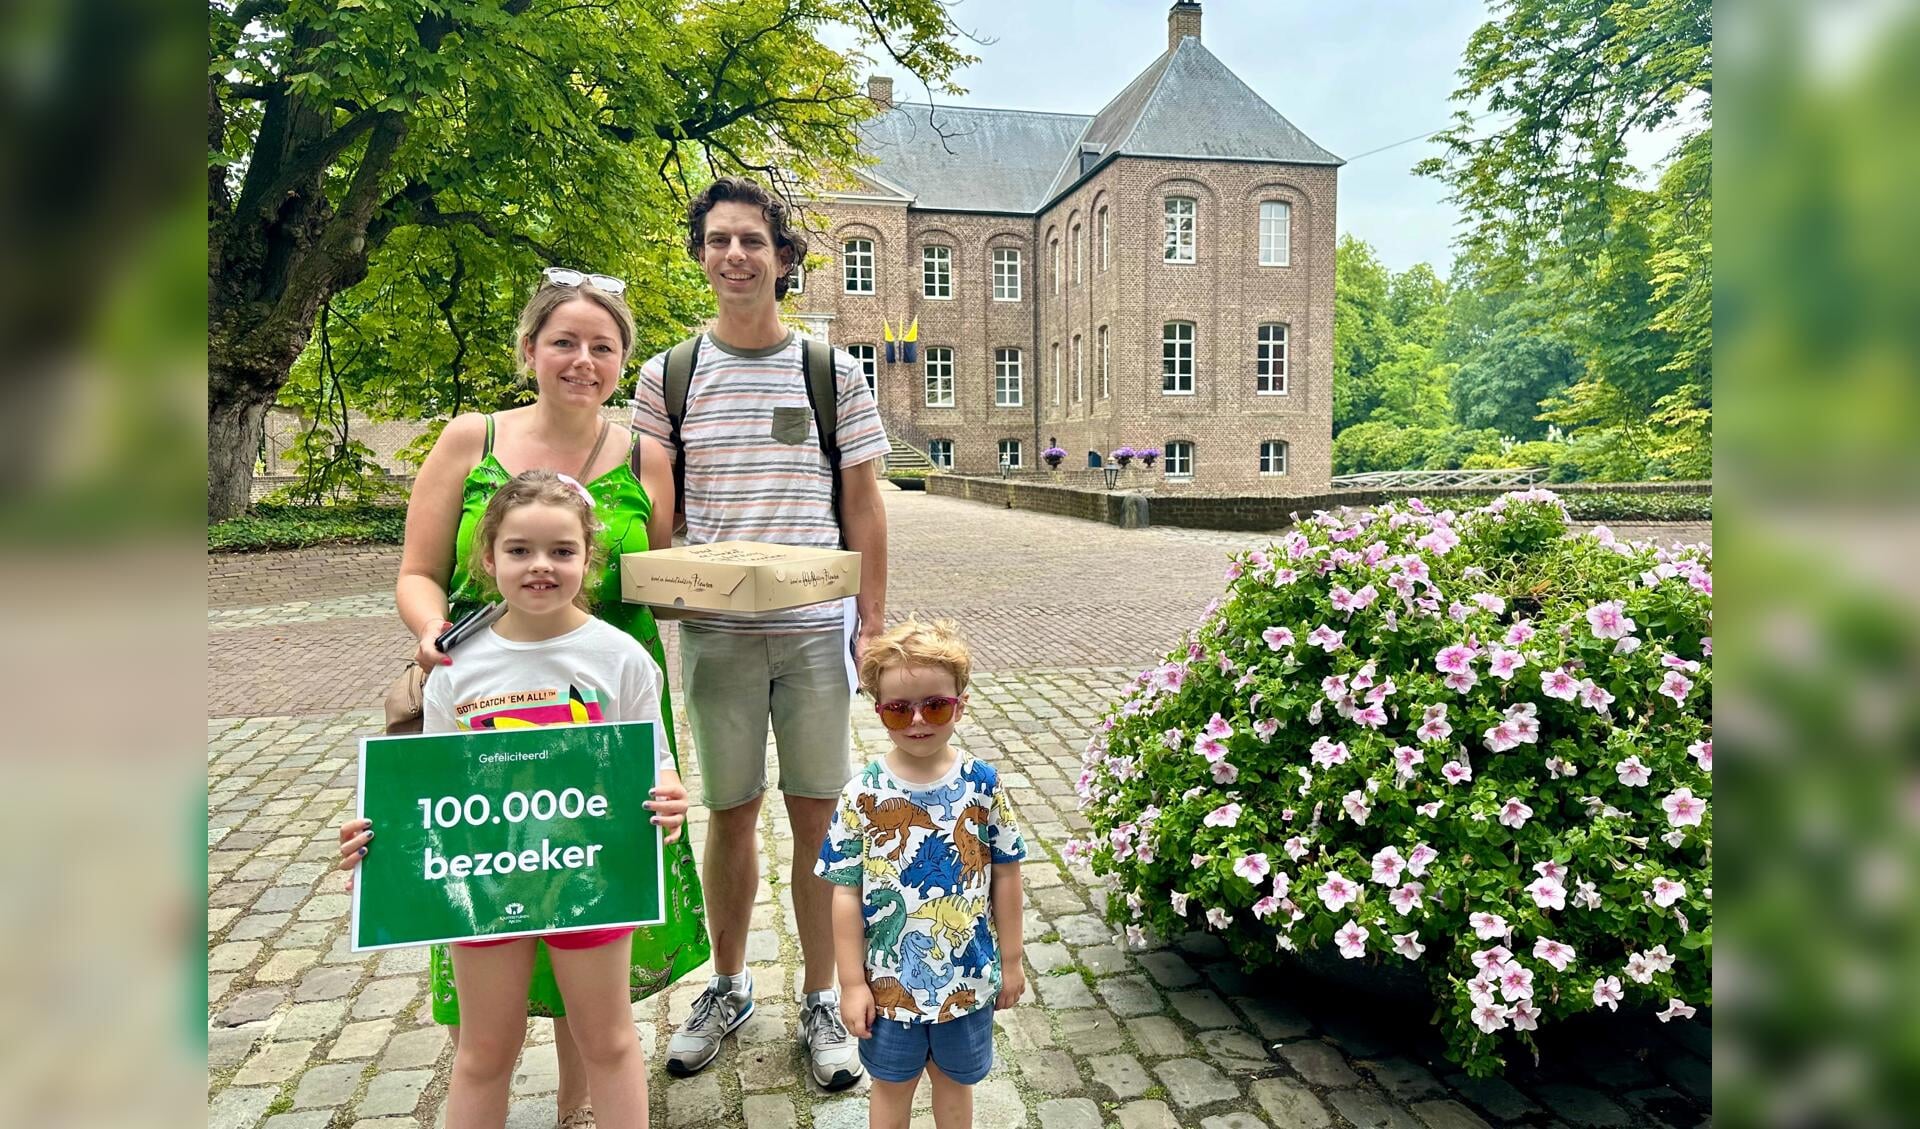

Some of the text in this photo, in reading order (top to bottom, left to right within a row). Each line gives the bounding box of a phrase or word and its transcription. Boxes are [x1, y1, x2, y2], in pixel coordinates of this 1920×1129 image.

[456, 703, 478, 715] GOTTA
[480, 697, 506, 709] CATCH
[507, 695, 524, 703] 'EM
[527, 692, 547, 701] ALL!
[479, 750, 549, 764] Gefeliciteerd!
[417, 787, 608, 830] 100.000e
[424, 838, 604, 880] bezoeker
